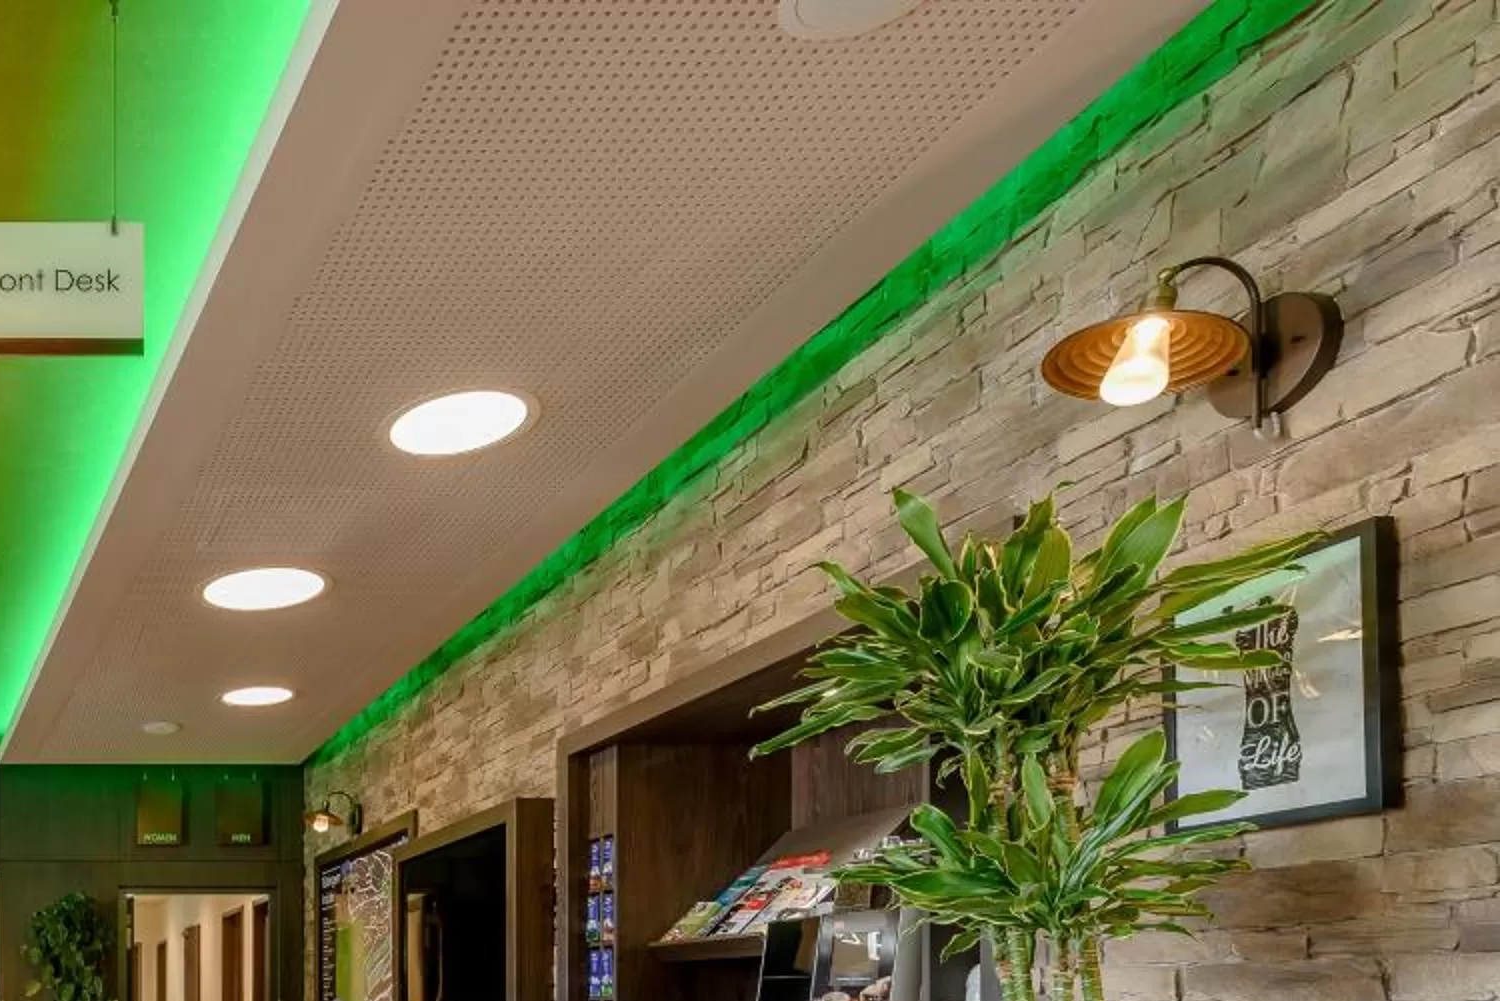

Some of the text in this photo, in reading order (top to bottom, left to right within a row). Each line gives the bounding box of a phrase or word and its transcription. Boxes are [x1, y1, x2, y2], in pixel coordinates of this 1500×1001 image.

[55, 268, 120, 292] Desk
[1247, 691, 1289, 728] OF
[1240, 732, 1301, 776] Life
